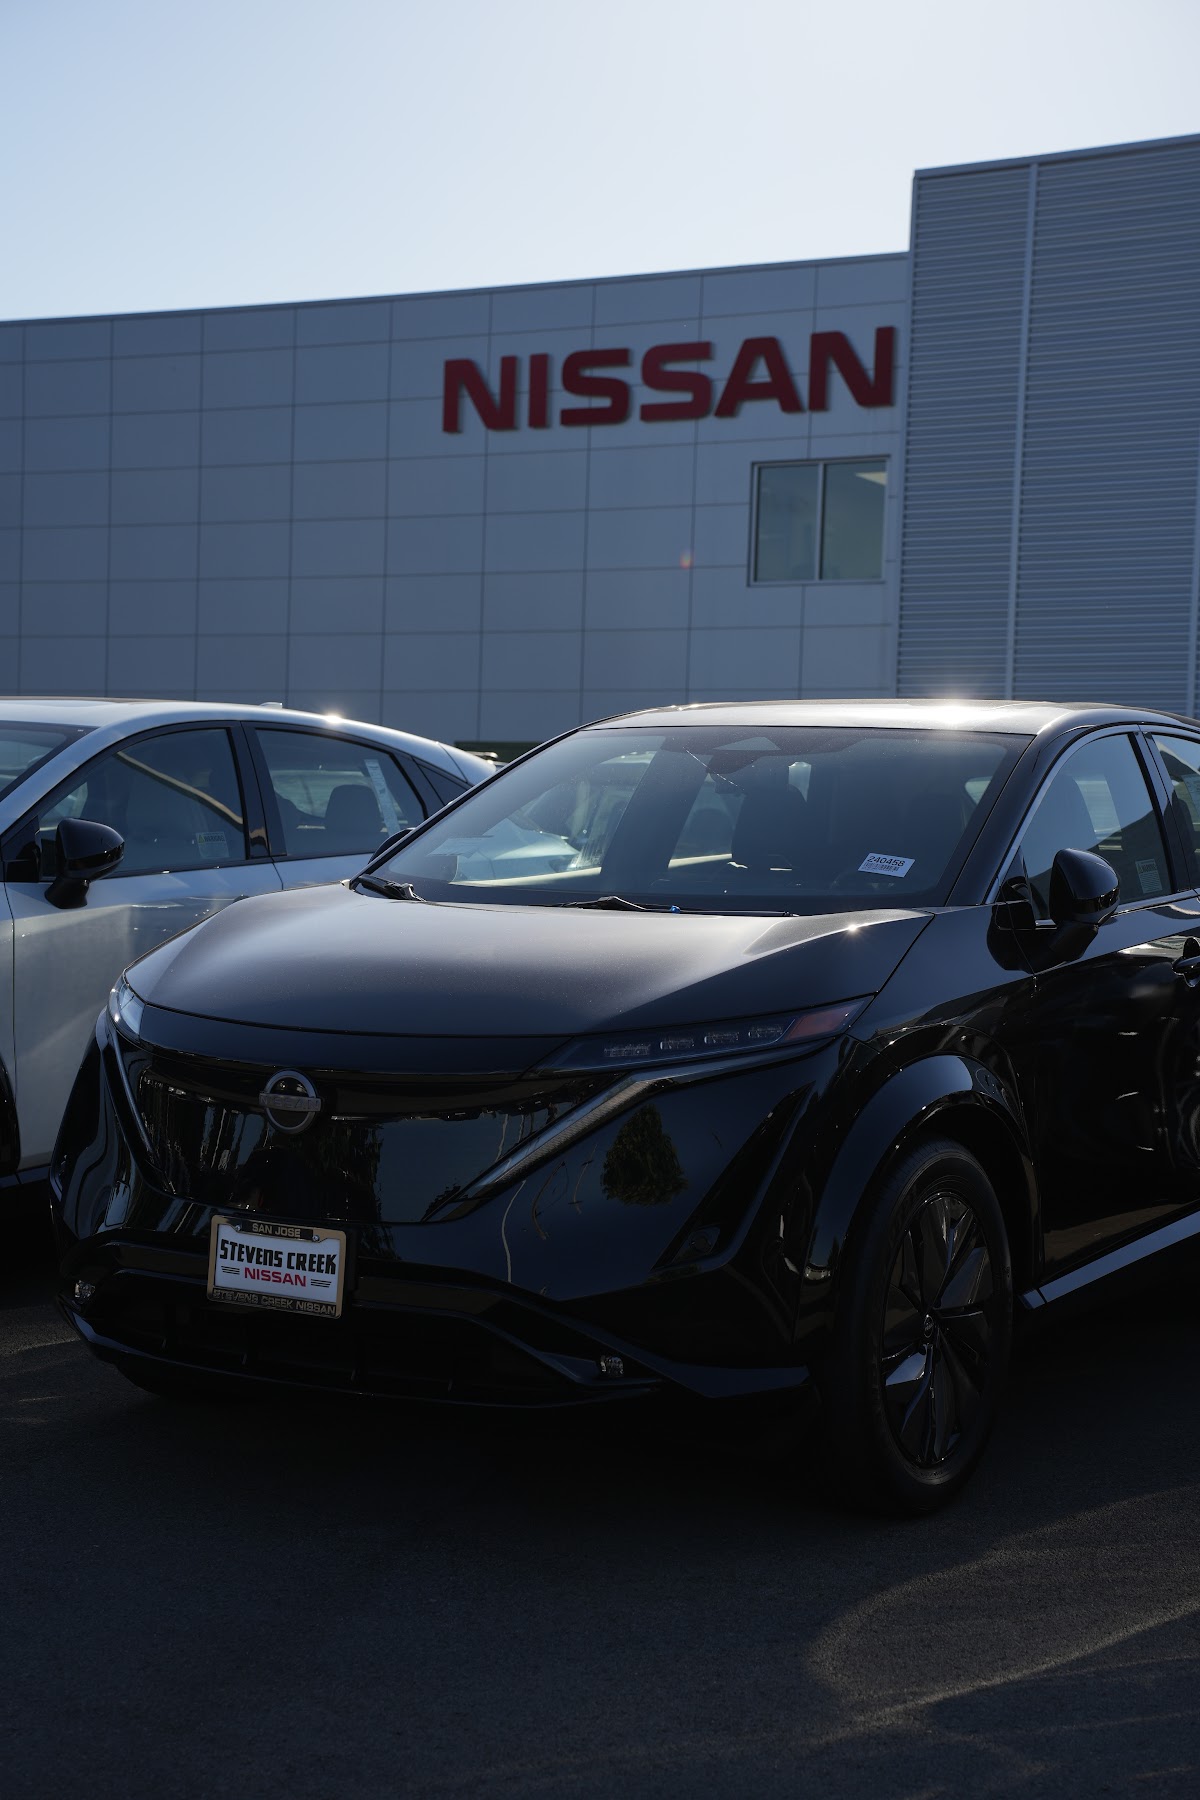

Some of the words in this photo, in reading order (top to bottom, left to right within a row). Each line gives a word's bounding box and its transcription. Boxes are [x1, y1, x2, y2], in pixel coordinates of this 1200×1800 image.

[443, 326, 895, 433] NISSAN
[868, 856, 905, 866] 240458
[260, 1095, 319, 1110] NSSAN
[252, 1223, 272, 1234] SAN
[275, 1226, 301, 1237] JOSE
[220, 1239, 283, 1267] STEVENS
[287, 1252, 338, 1274] CREEK
[244, 1267, 307, 1287] NISSAN
[213, 1289, 259, 1304] STEVENS
[261, 1296, 293, 1309] CREEK
[296, 1301, 335, 1315] NISSAN
